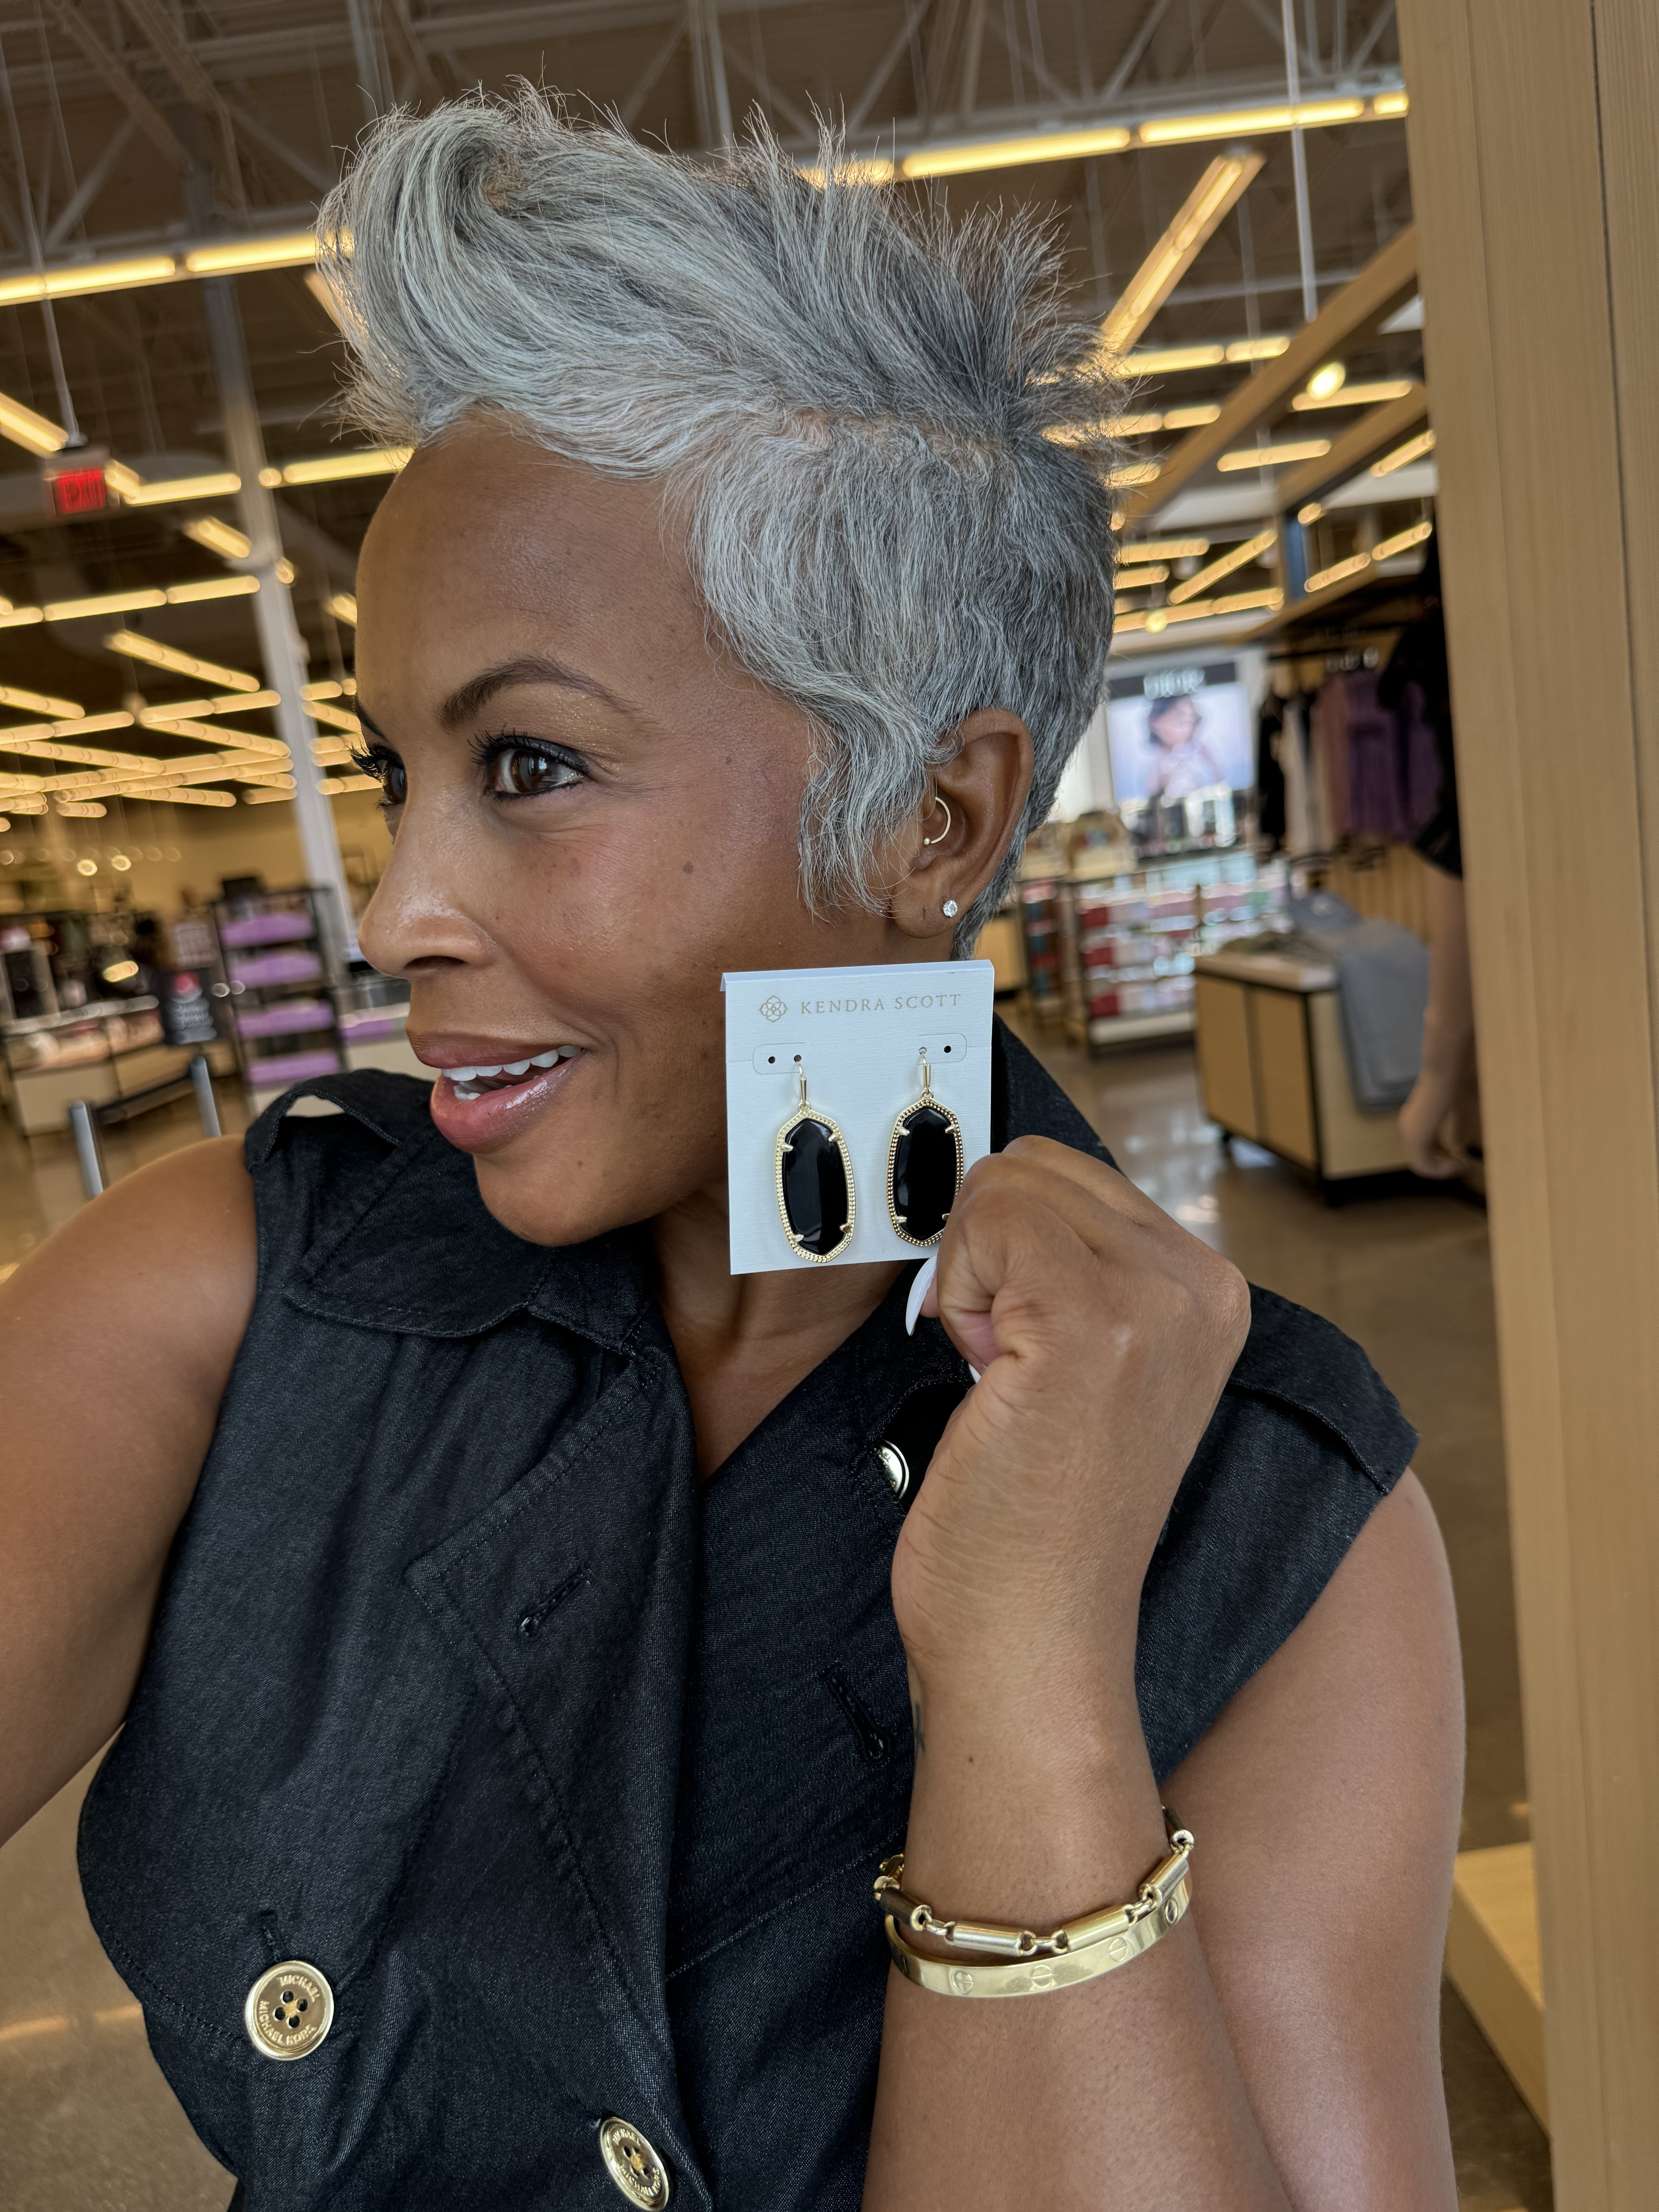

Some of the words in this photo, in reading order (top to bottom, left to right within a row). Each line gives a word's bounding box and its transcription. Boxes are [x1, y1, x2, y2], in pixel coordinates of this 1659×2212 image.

[801, 998, 884, 1014] KENDRA
[895, 994, 961, 1009] SCOTT
[279, 1975, 320, 2002] MICHAEL
[259, 2000, 284, 2044] MICHAEL
[286, 2024, 317, 2045] KORS
